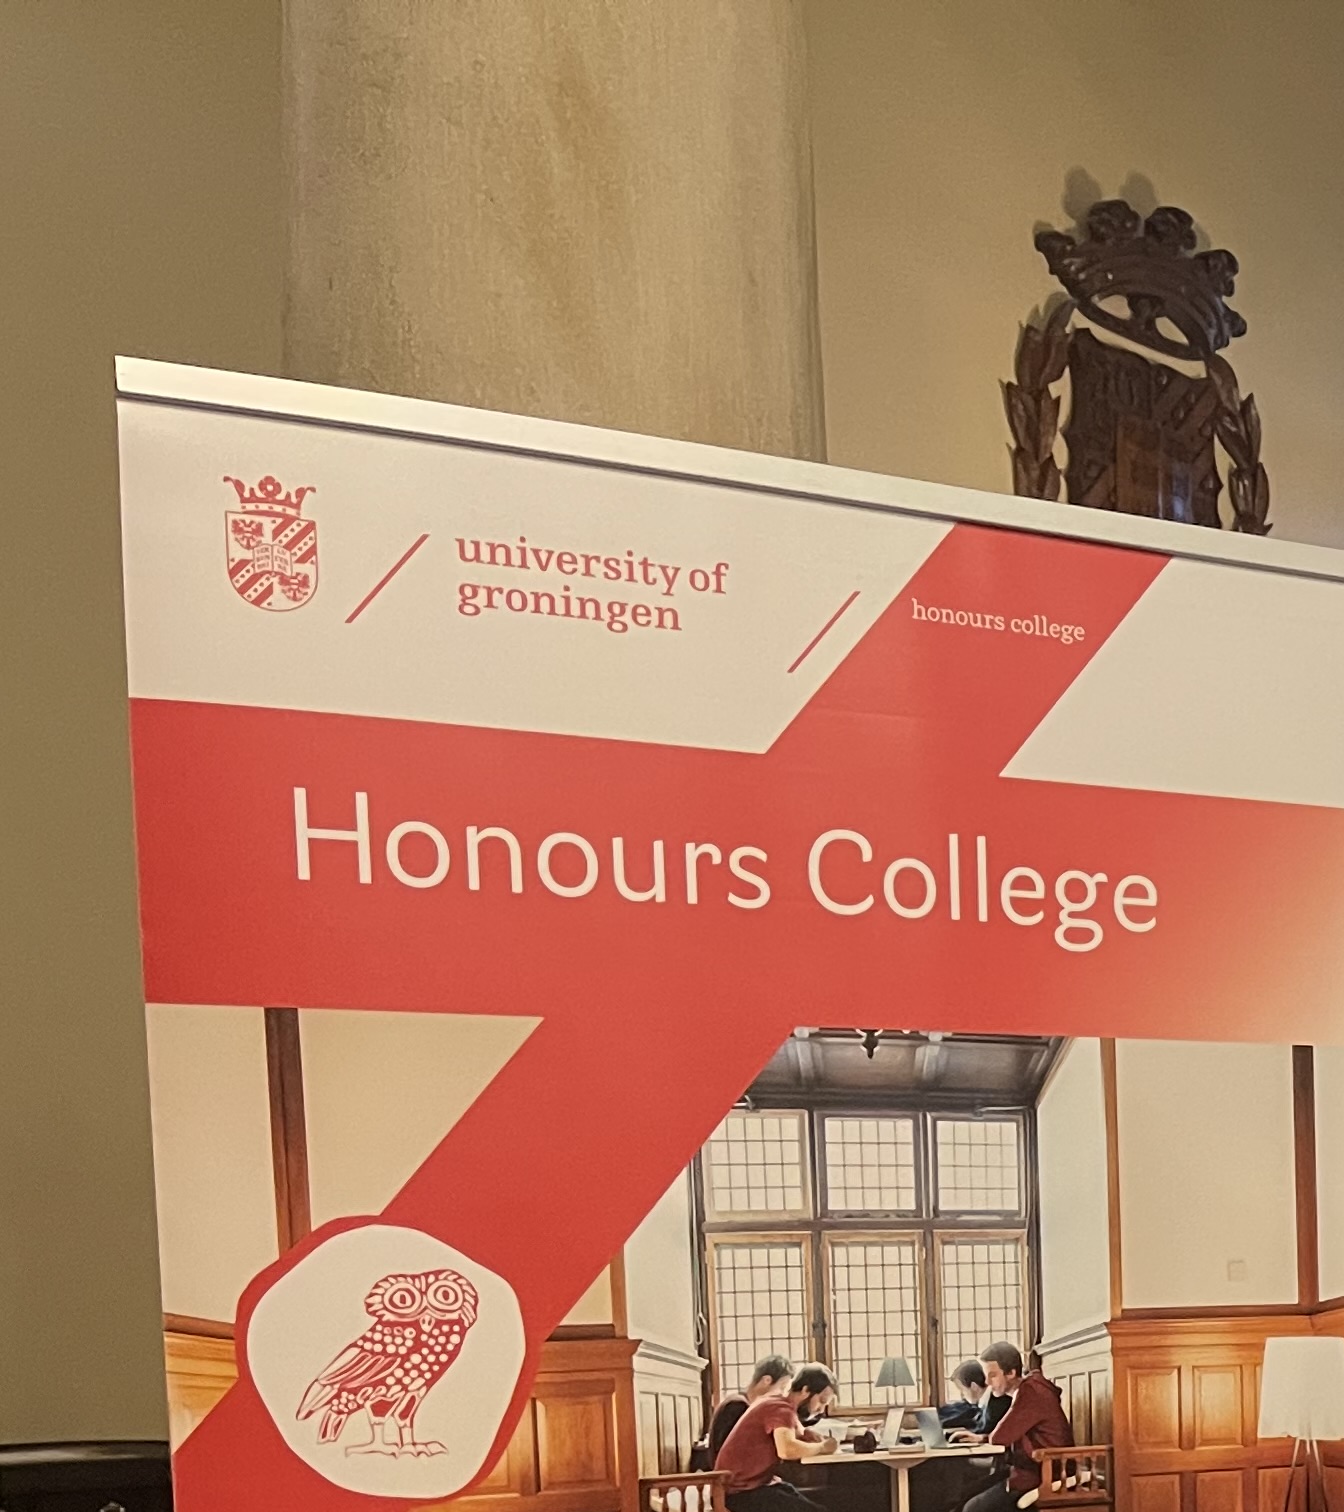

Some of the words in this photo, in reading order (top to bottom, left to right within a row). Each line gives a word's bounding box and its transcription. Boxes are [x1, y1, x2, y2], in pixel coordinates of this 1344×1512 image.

[455, 536, 681, 596] university
[690, 563, 729, 594] of
[458, 584, 682, 633] groningen
[912, 598, 1005, 630] honours
[1011, 615, 1085, 644] college
[294, 787, 770, 908] Honours
[808, 829, 1157, 952] College
